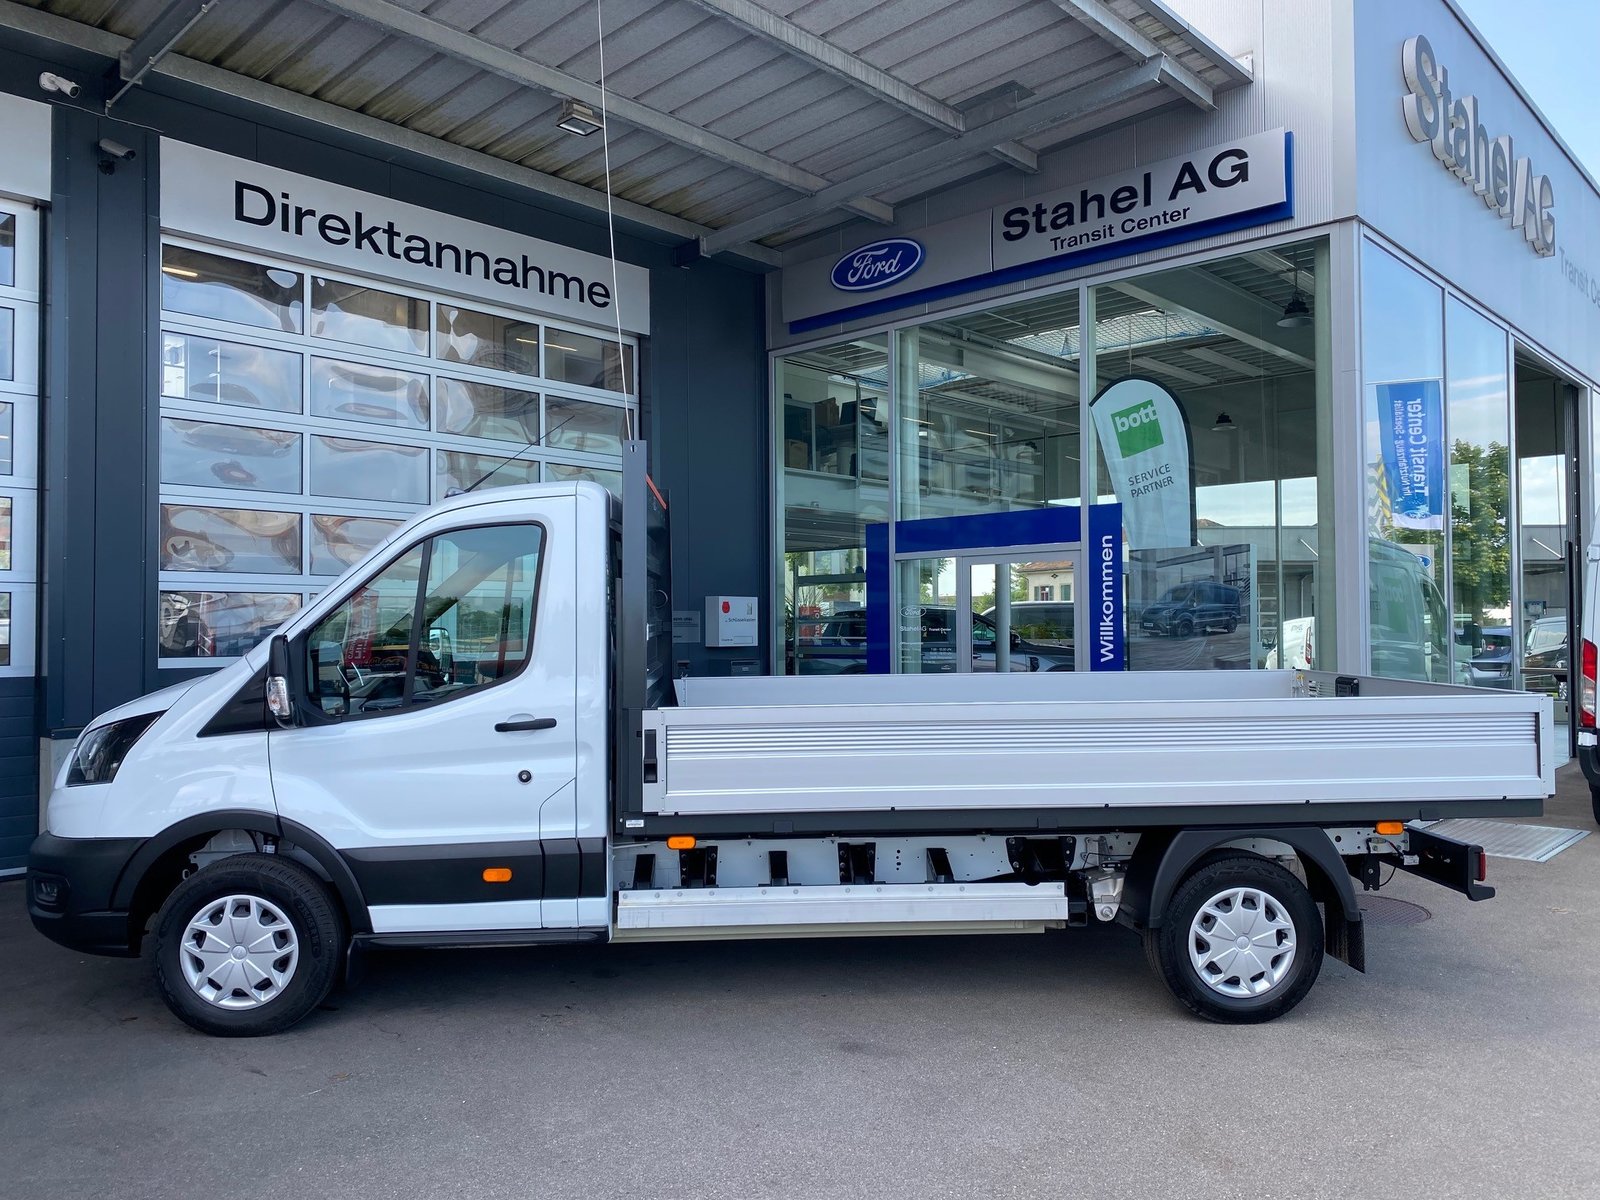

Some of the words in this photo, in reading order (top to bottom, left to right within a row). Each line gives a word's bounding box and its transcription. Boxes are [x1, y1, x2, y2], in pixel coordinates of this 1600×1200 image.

[1402, 34, 1514, 219] Stahel
[1512, 157, 1556, 258] AG
[1002, 172, 1152, 242] Stahel
[1168, 148, 1249, 201] AG
[234, 180, 611, 309] Direktannahme
[1050, 224, 1115, 251] Transit
[1121, 207, 1190, 234] Center
[1559, 246, 1589, 299] Transit
[1115, 404, 1159, 433] bott
[1128, 463, 1171, 486] SERVICE
[1130, 475, 1175, 498] PARTNER
[1099, 535, 1115, 662] Willkommen
